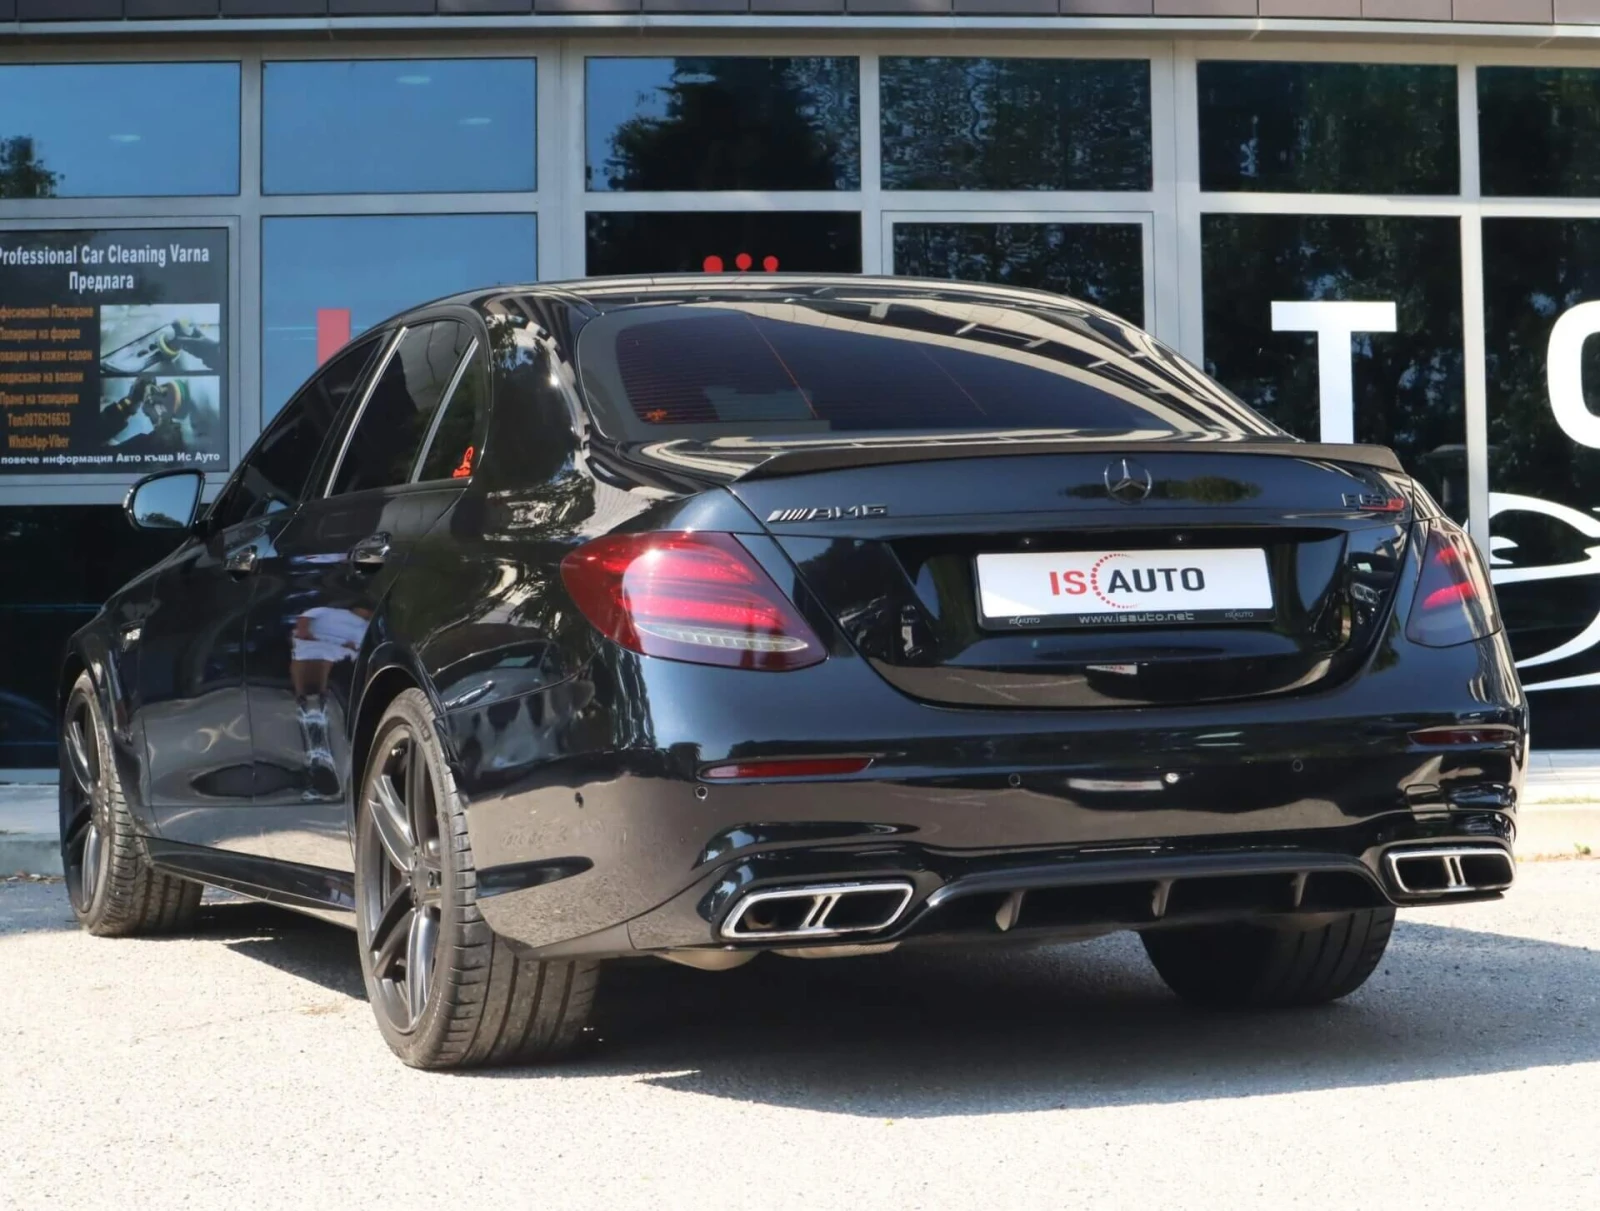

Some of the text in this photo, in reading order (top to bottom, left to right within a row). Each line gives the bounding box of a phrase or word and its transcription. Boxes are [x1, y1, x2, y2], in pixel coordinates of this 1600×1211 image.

[82, 247, 104, 264] Car
[108, 244, 166, 267] Cleaning
[170, 243, 209, 262] Varna
[69, 271, 134, 294] Предлага
[1, 451, 220, 465] повече информация Авто къща Ис Ауто
[1108, 567, 1205, 594] AUTO
[1078, 611, 1195, 625] www.isauto.net
